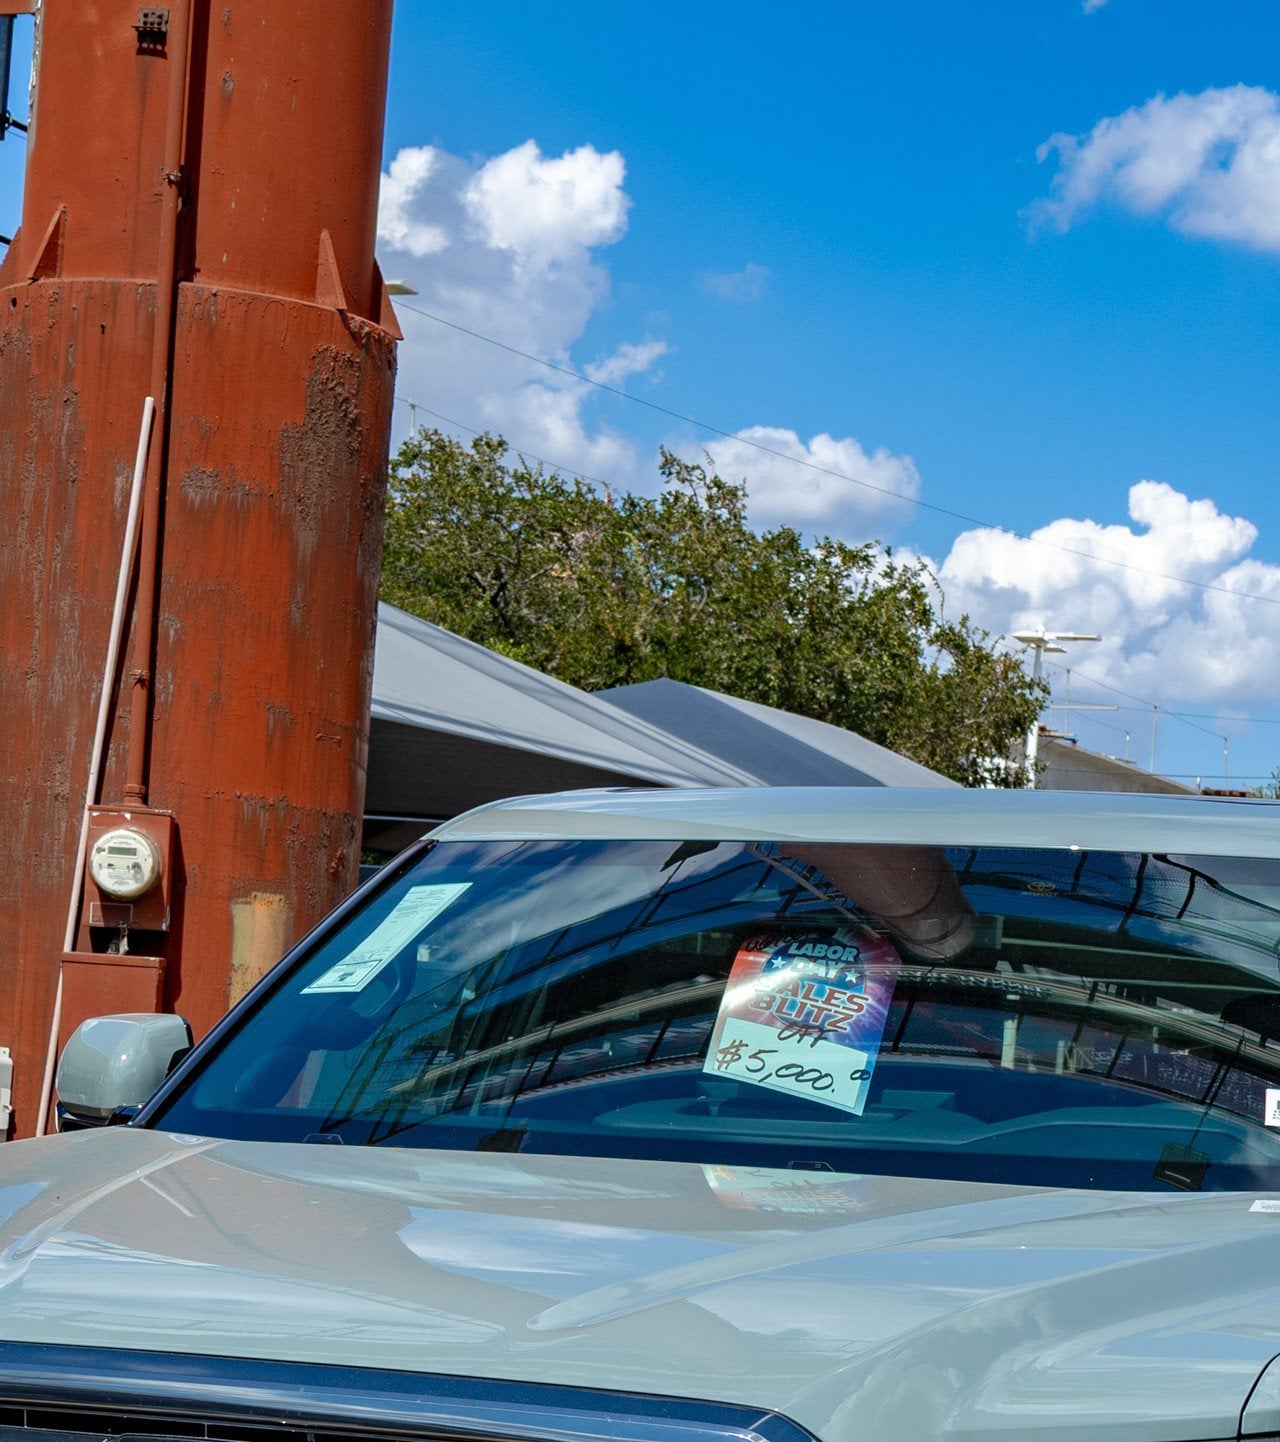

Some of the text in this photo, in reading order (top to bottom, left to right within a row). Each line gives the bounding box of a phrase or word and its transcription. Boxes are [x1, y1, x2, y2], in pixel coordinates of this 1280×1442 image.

[788, 942, 858, 962] LABOR
[790, 957, 847, 980] DAY
[766, 977, 869, 1014] ALES
[750, 991, 854, 1032] BLITZ
